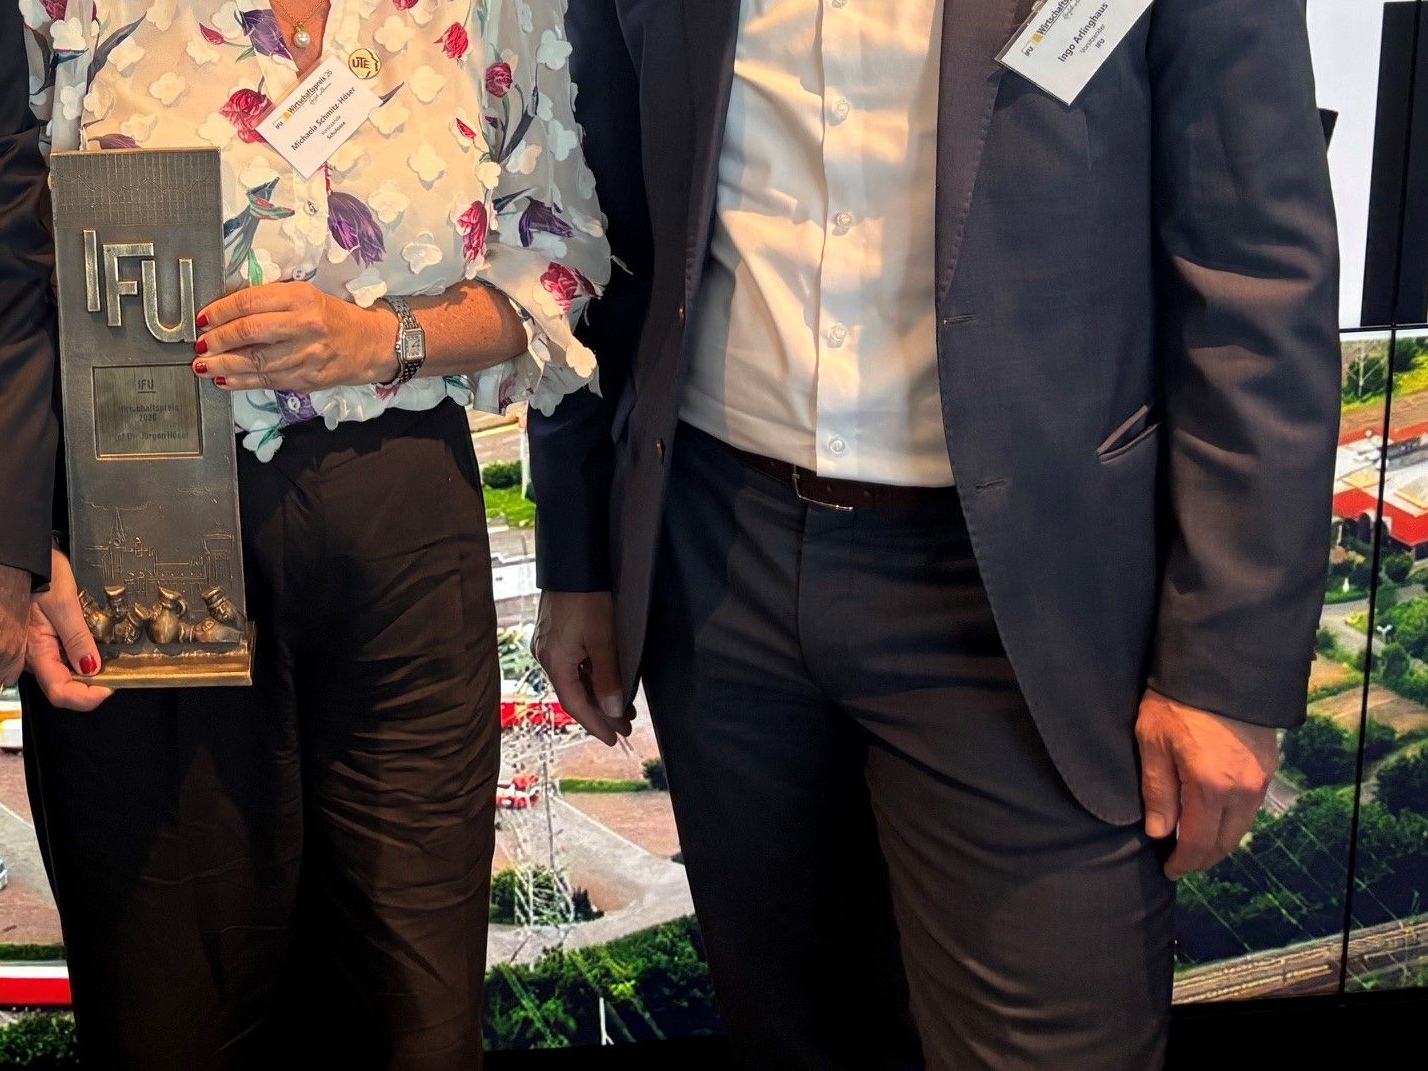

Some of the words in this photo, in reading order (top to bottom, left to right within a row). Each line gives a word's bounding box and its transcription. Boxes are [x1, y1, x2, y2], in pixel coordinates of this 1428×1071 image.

[1058, 44, 1075, 63] Ingo
[1074, 2, 1108, 44] Arlinghaus
[1095, 38, 1106, 49] IFU
[287, 76, 326, 114] Wirtschaftspreis
[290, 125, 318, 151] Michaela
[316, 86, 356, 126] Schmitz-Höser
[83, 229, 197, 342] IFU
[138, 379, 155, 390] IFU
